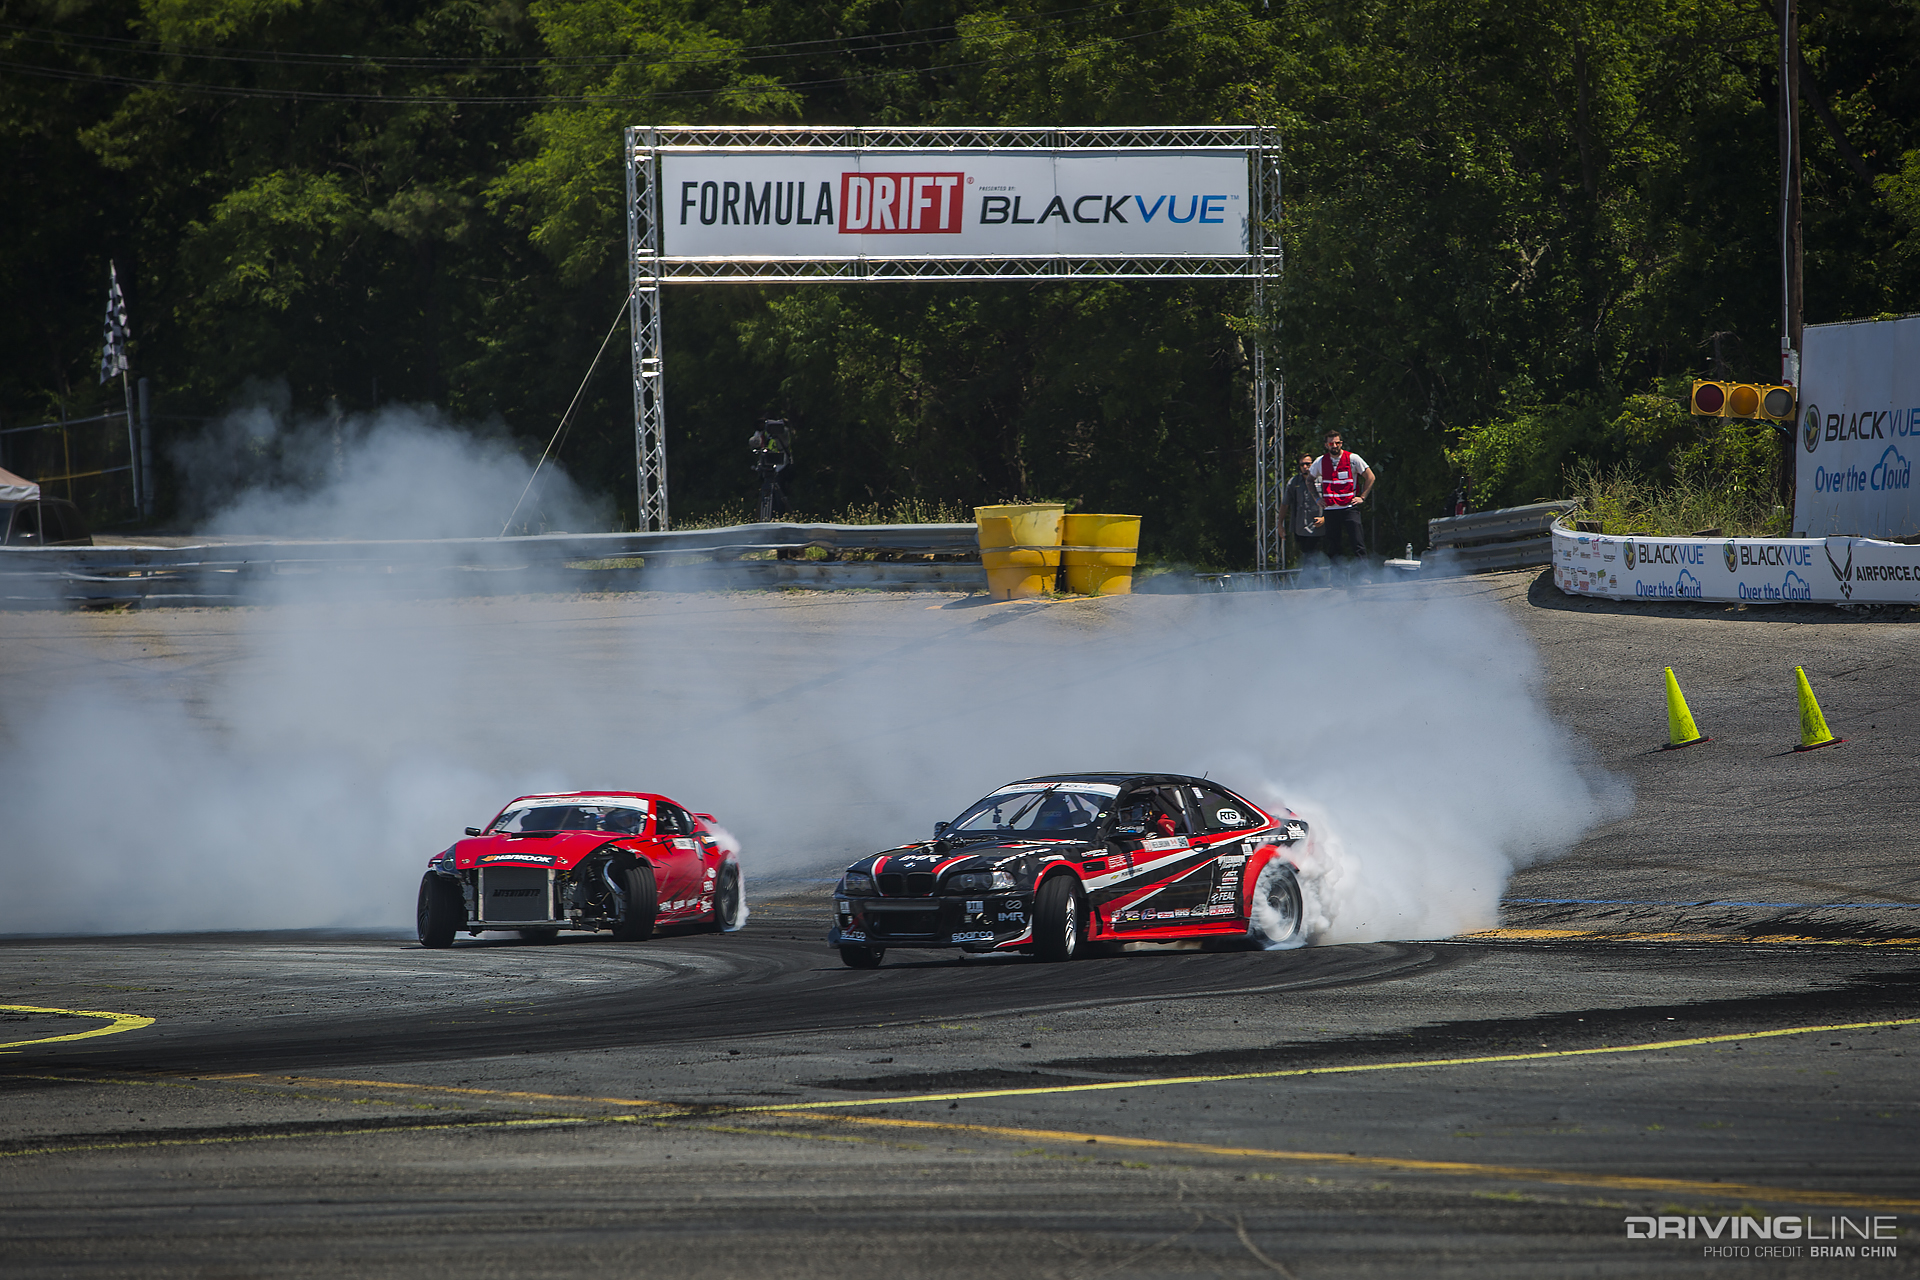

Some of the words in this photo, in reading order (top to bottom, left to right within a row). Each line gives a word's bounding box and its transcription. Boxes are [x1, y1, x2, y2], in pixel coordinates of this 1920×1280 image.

[680, 181, 834, 226] FORMULA
[846, 176, 958, 230] DRIFT
[980, 195, 1227, 224] BLACKVUE
[1825, 408, 1920, 441] BLACKVUE
[1815, 465, 1845, 493] Over
[1847, 464, 1867, 492] the
[1871, 449, 1911, 491] Cloud
[1639, 545, 1704, 565] BLACKVUE
[1741, 546, 1812, 566] BLACKVUE
[1636, 580, 1656, 598] Over
[1658, 580, 1674, 598] the
[1676, 572, 1701, 599] Cloud
[1739, 581, 1759, 600] Over
[1761, 582, 1780, 600] the
[1782, 573, 1811, 600] Cloud
[951, 930, 994, 941] sparco
